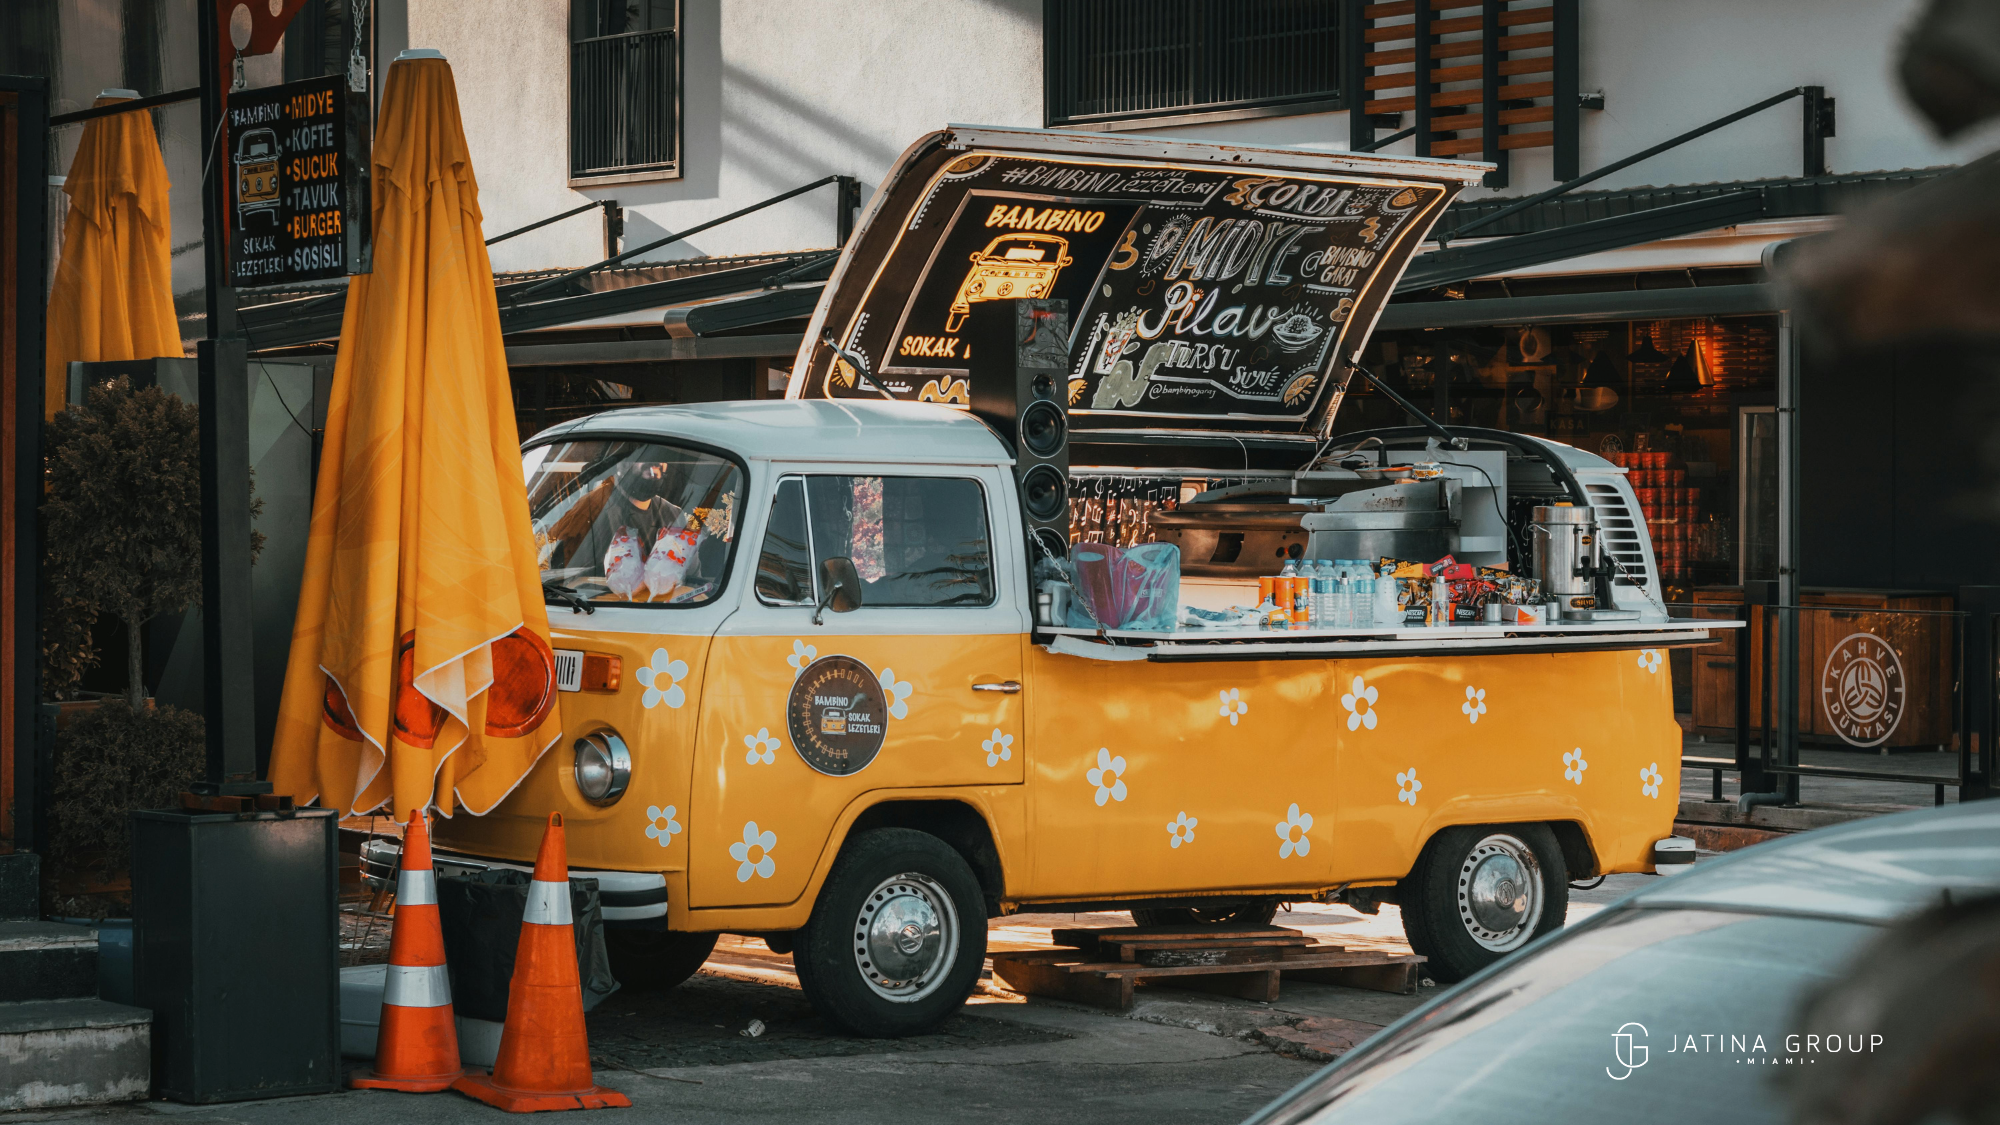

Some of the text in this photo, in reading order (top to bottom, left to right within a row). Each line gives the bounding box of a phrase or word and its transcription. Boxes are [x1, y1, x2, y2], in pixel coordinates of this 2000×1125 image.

[291, 89, 334, 120] MİDYE
[291, 120, 334, 152] KÖFTE
[293, 152, 339, 182] SUCUK
[293, 182, 339, 211] TAVUK
[293, 210, 342, 239] BURGER
[899, 335, 960, 358] SOKAK
[1550, 419, 1584, 430] KASA
[1830, 642, 1897, 679] KAHVE
[848, 712, 871, 723] SOKAK
[1830, 701, 1898, 739] DÜNYASI
